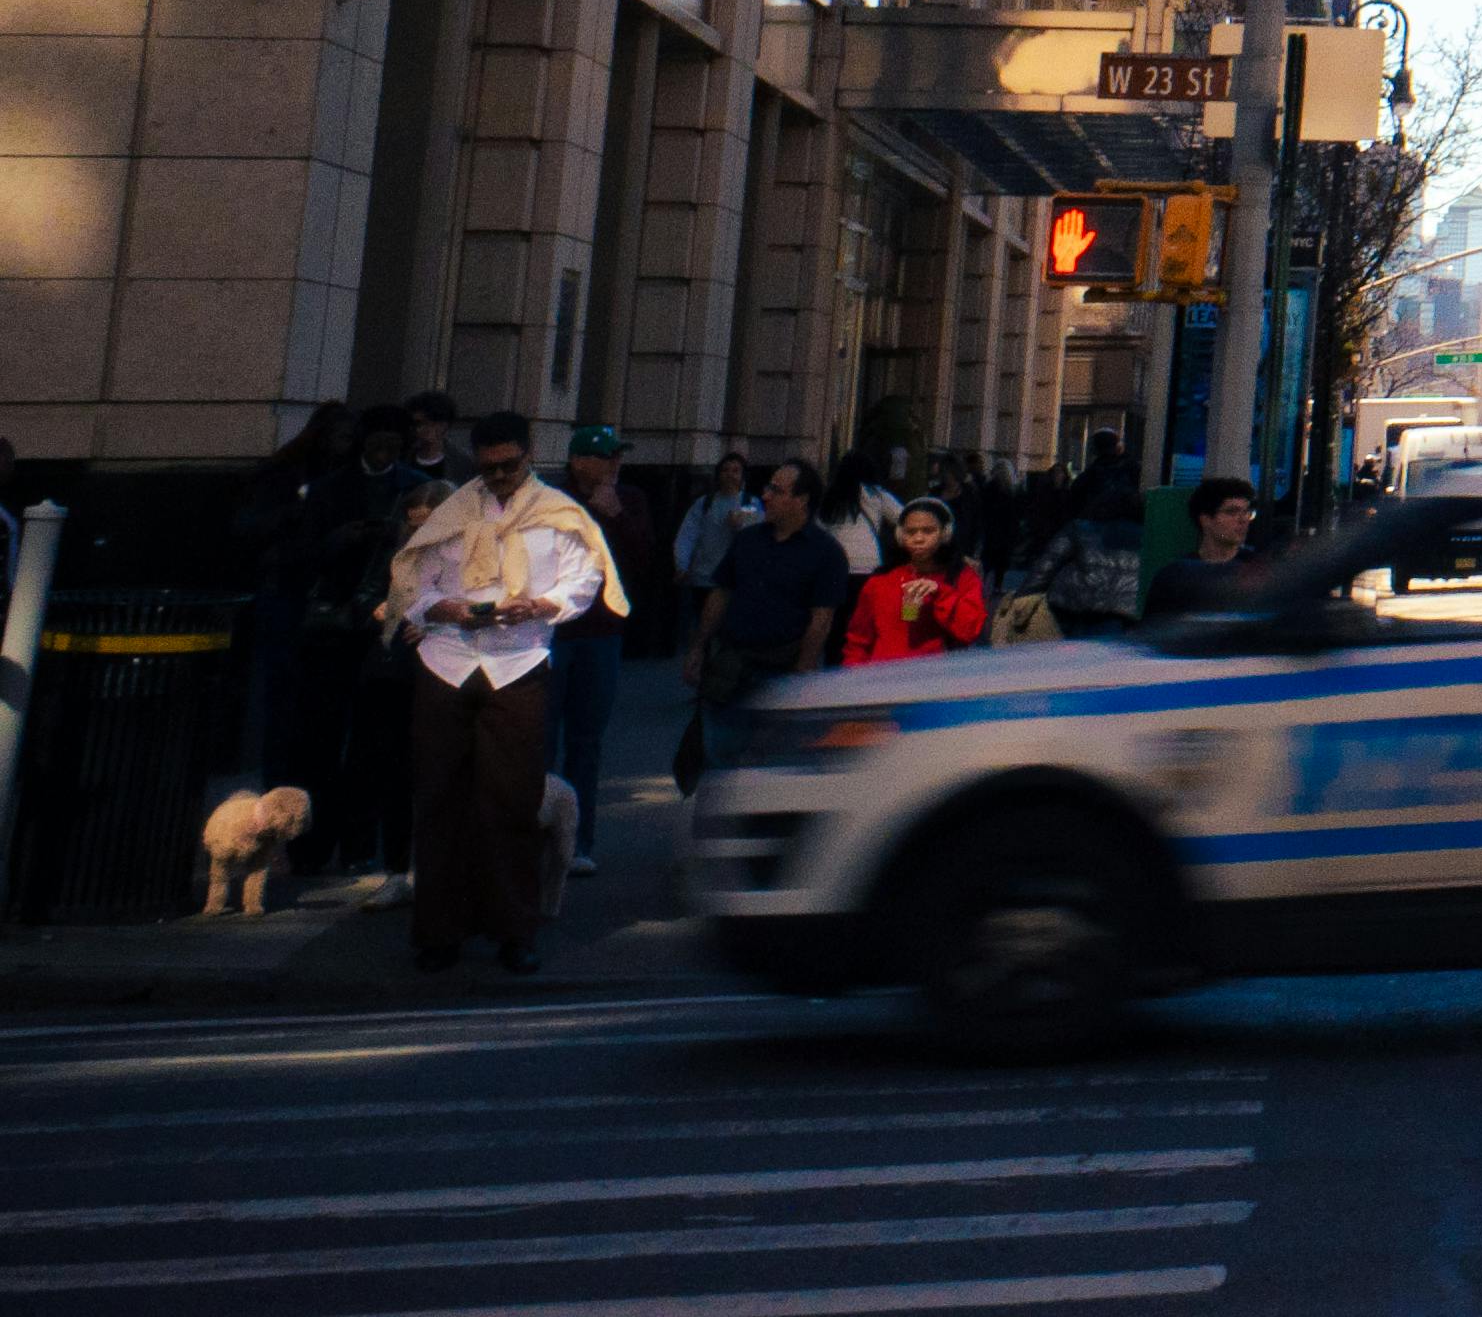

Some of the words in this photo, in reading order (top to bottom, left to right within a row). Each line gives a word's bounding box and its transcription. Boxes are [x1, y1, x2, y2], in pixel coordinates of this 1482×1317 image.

[1108, 66, 1133, 94] W
[1143, 66, 1172, 95] 23
[1184, 67, 1214, 96] St
